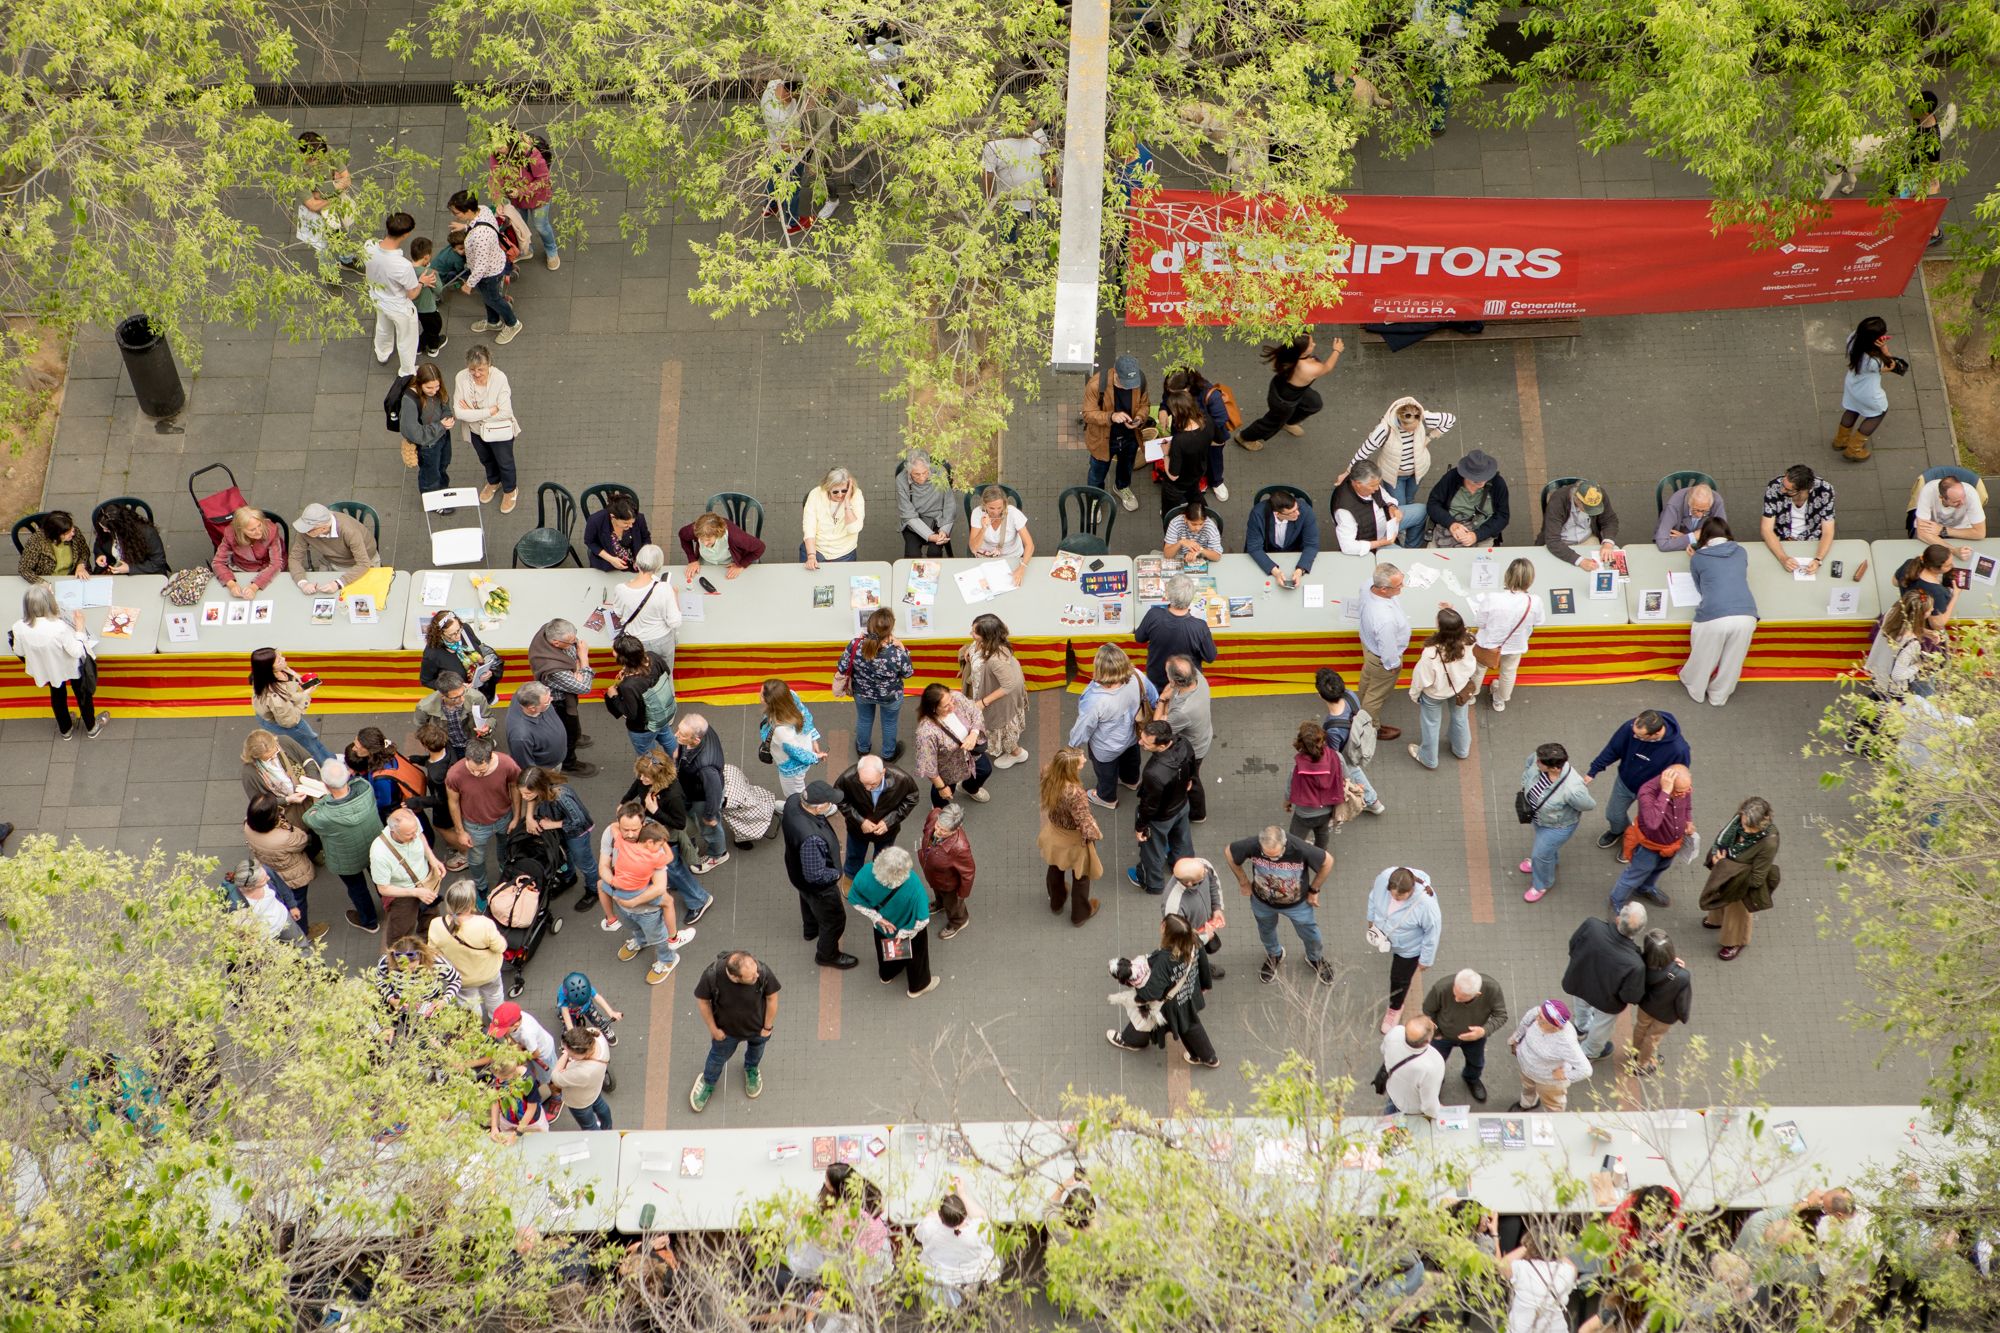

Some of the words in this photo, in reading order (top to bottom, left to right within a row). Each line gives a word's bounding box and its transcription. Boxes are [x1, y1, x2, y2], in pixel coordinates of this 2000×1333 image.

[1374, 298, 1445, 307] Fundació
[1511, 301, 1577, 309] Generalitat
[1373, 306, 1457, 315] FLUIDRA
